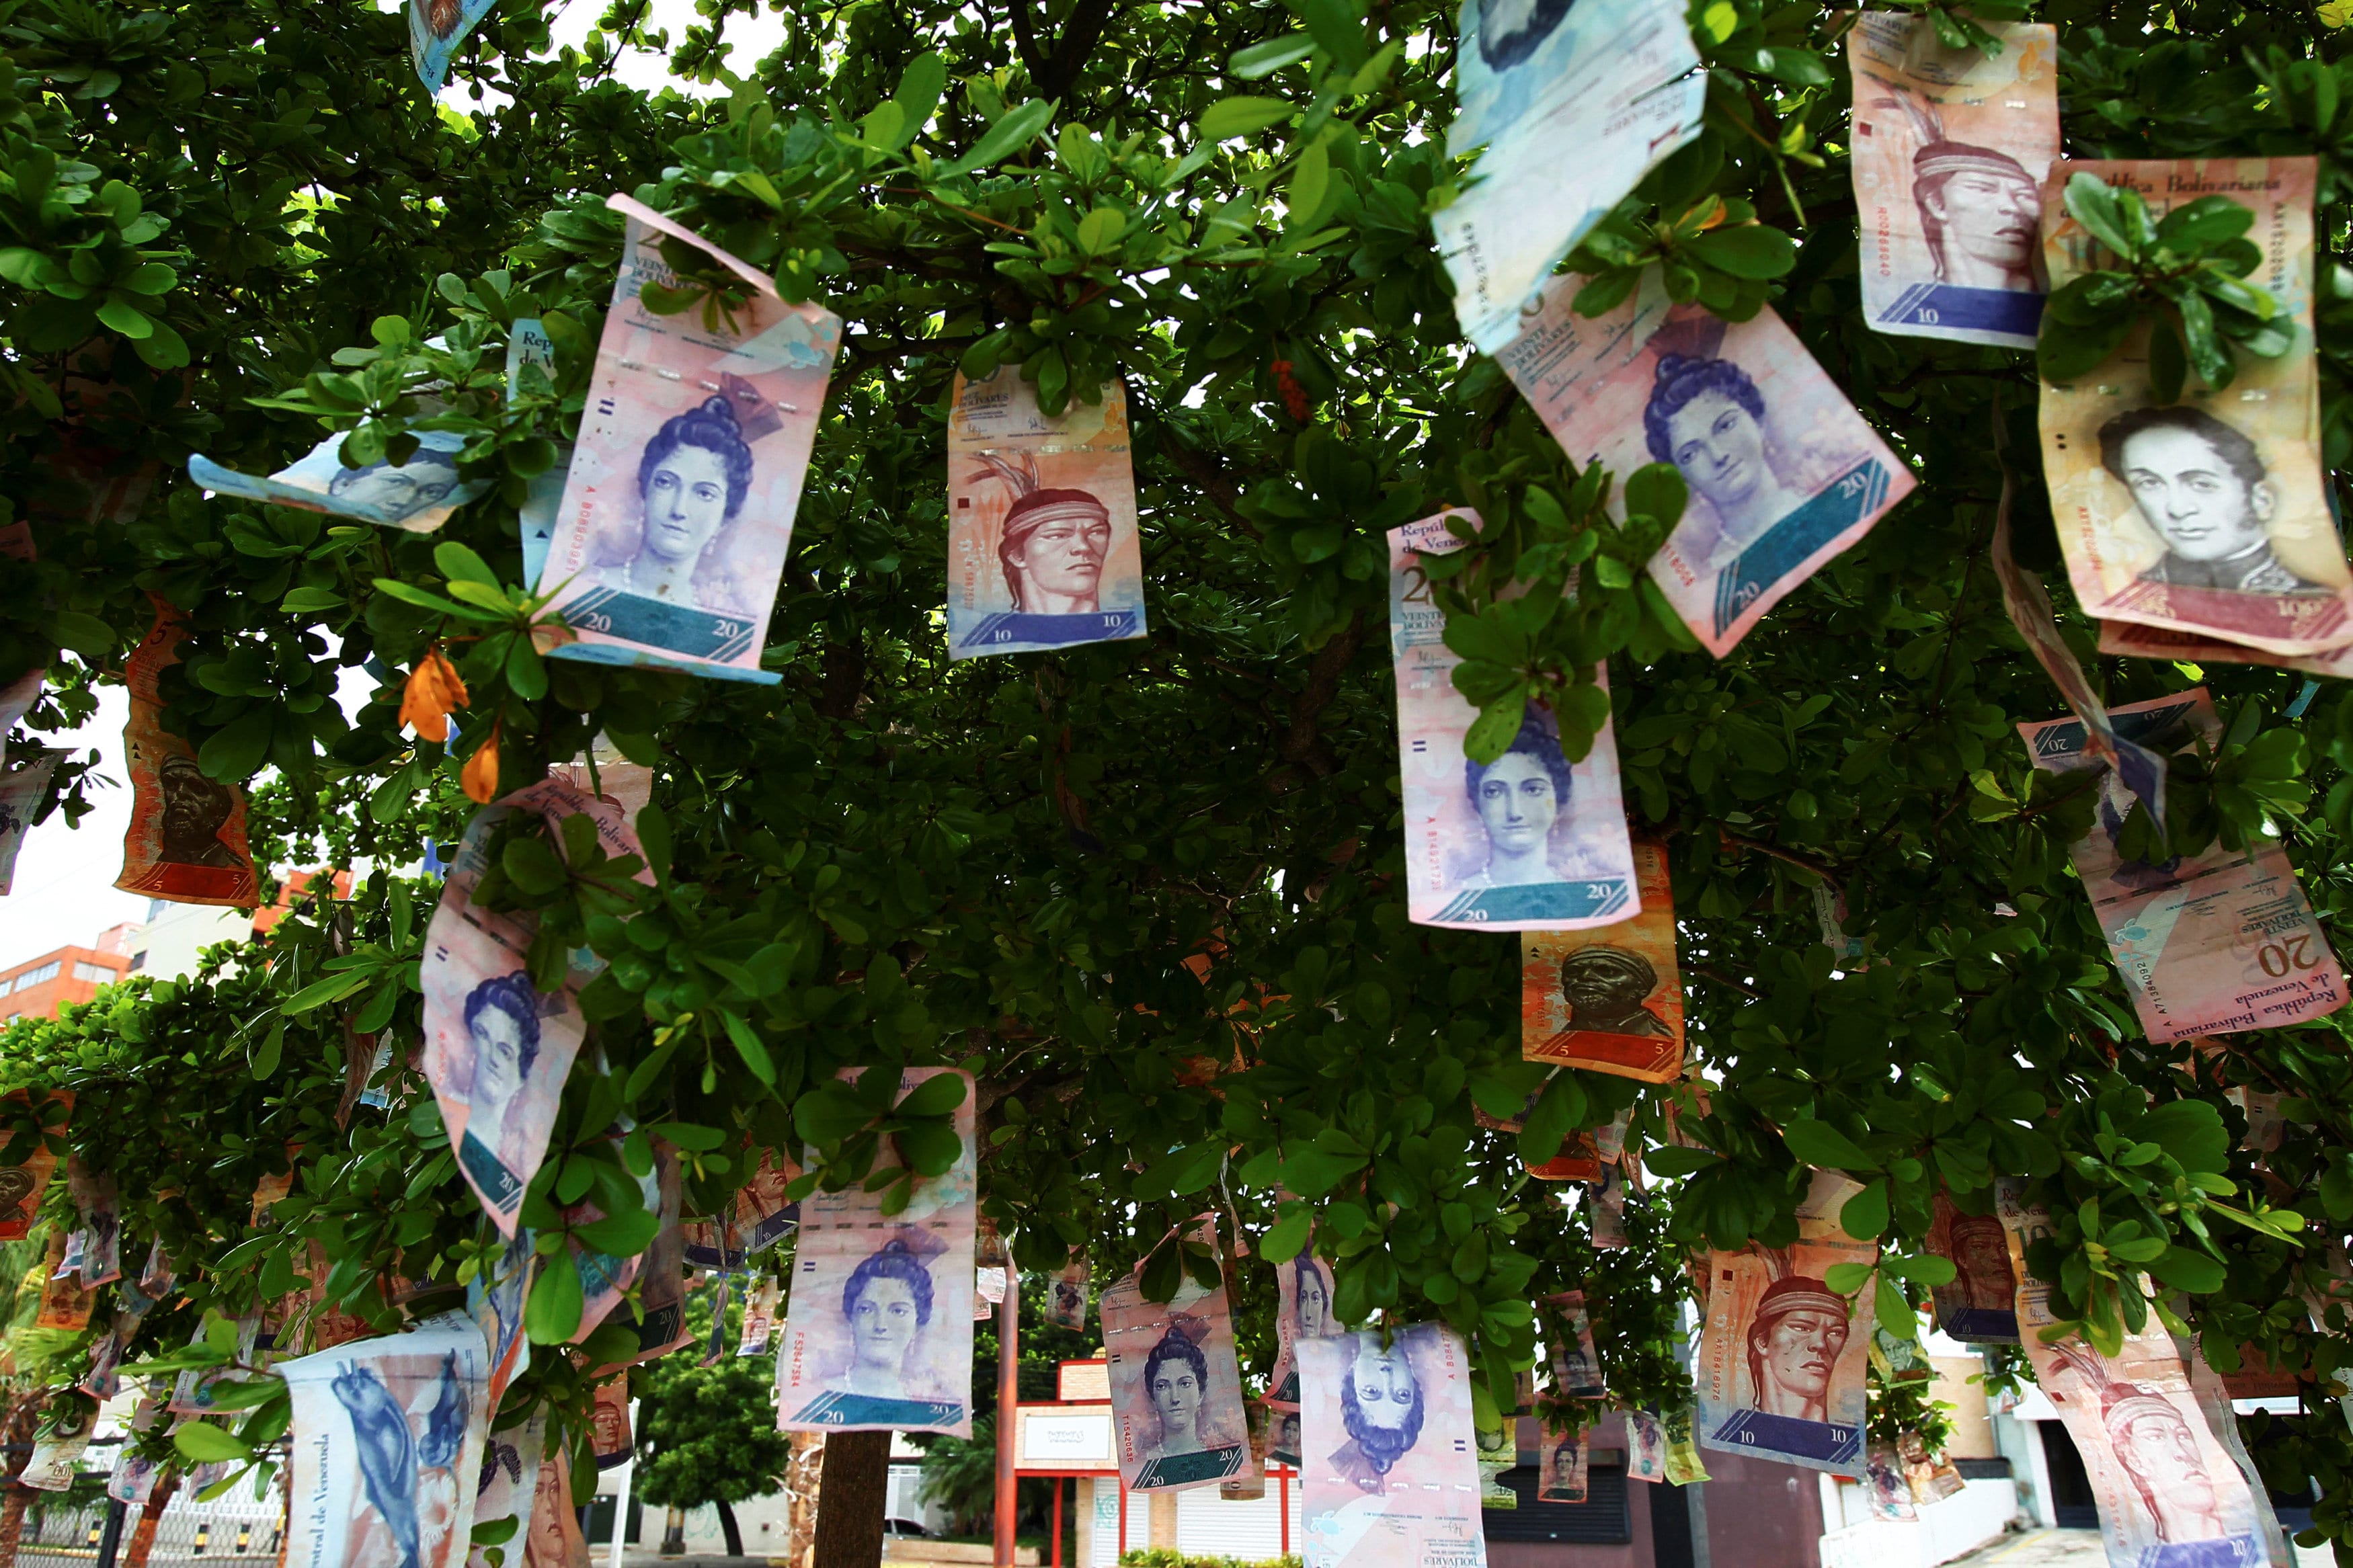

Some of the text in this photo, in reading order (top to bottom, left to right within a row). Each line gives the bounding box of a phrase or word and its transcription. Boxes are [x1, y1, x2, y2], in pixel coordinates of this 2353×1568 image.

[1917, 308, 1939, 324] 10
[1837, 471, 1870, 499] 20
[584, 611, 740, 639] 20 20
[1102, 614, 1121, 628] 10
[993, 629, 1012, 643] 10
[2048, 738, 2069, 752] 20
[153, 880, 163, 891] 5
[232, 874, 241, 884] 5
[1586, 882, 1613, 899] 20
[1463, 909, 1488, 922] 20
[2258, 933, 2319, 978] 20
[2235, 973, 2330, 1010] de Venezuela
[2173, 989, 2338, 1039] República Bolivariana
[1560, 1045, 1570, 1057] 5
[1654, 1042, 1665, 1055] 5
[658, 1311, 672, 1325] 20
[1961, 1323, 1971, 1333] 10
[1284, 1389, 1293, 1401] 20
[823, 1410, 844, 1425] 20
[1122, 1415, 1135, 1463] T15420636
[1740, 1430, 1755, 1445] 10
[1831, 1428, 1847, 1444] 10
[1219, 1449, 1233, 1462] 20
[312, 1433, 330, 1503] Venezuela
[1150, 1475, 1164, 1487] 20
[313, 1509, 329, 1526] de
[2231, 1540, 2247, 1557] 10
